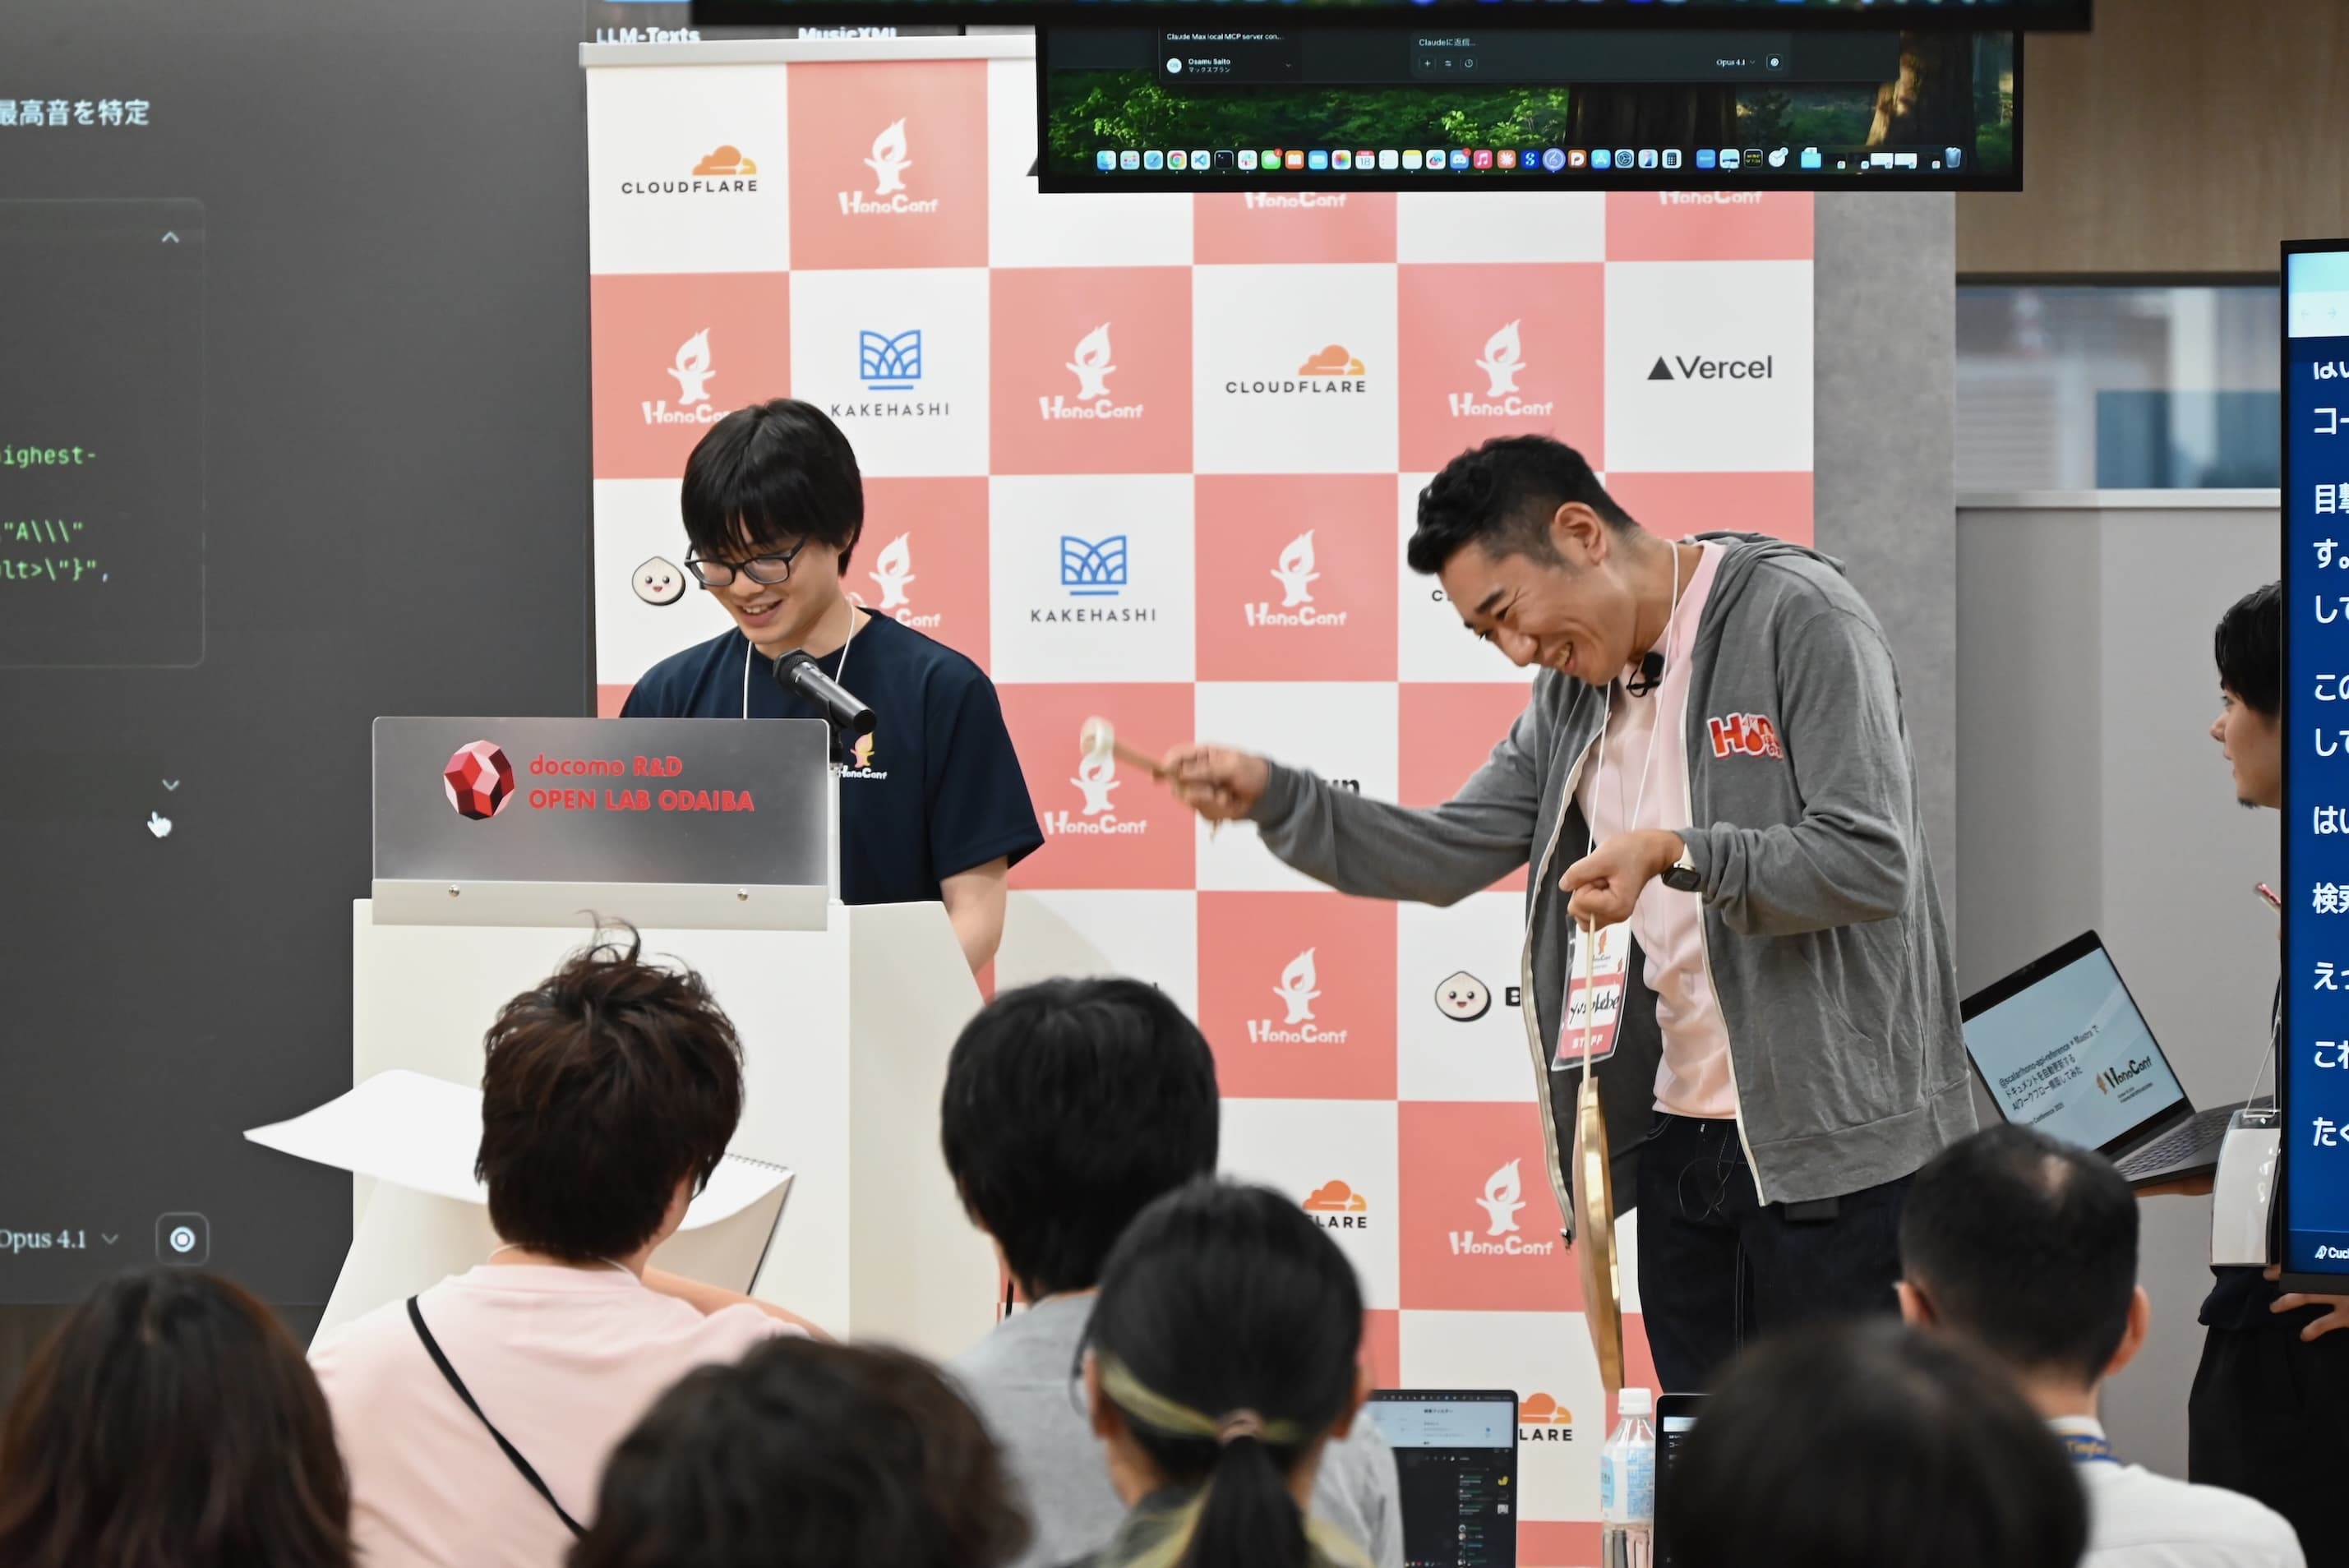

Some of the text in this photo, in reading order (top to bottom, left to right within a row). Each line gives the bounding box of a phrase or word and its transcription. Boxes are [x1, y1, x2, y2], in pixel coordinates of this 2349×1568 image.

[596, 27, 700, 44] LLM-Texts
[1716, 59, 1735, 67] Opus
[0, 98, 151, 127] 最高音を特定
[1359, 157, 1371, 166] 18
[621, 180, 758, 194] CLOUDFLARE
[838, 191, 939, 215] HonoConf
[1244, 191, 1347, 210] HonoConf
[1675, 355, 1772, 379] Vercel
[1225, 380, 1367, 394] CLOUDFLARE
[642, 400, 731, 425] HonoCo
[831, 403, 948, 417] KAKEHASHI
[1040, 394, 1143, 421] HonoConf
[1449, 393, 1553, 417] HonoConf
[0, 445, 96, 468] ighest-
[0, 557, 108, 583] lt>\"}",
[1031, 609, 1156, 622] KAKEHASHI
[1244, 602, 1347, 626] HonoConf
[529, 753, 683, 777] docomo R&D
[838, 765, 888, 780] HonoConf
[528, 789, 755, 811] OPEN LAB ODAIBA
[1044, 811, 1147, 835] HonoConf
[1248, 1020, 1348, 1044] HonoConf
[1572, 1035, 1603, 1049] STFF
[2103, 1055, 2152, 1089] HonoConf
[0, 1229, 86, 1254] Opus 4.1
[1449, 1231, 1553, 1256] HonoConf
